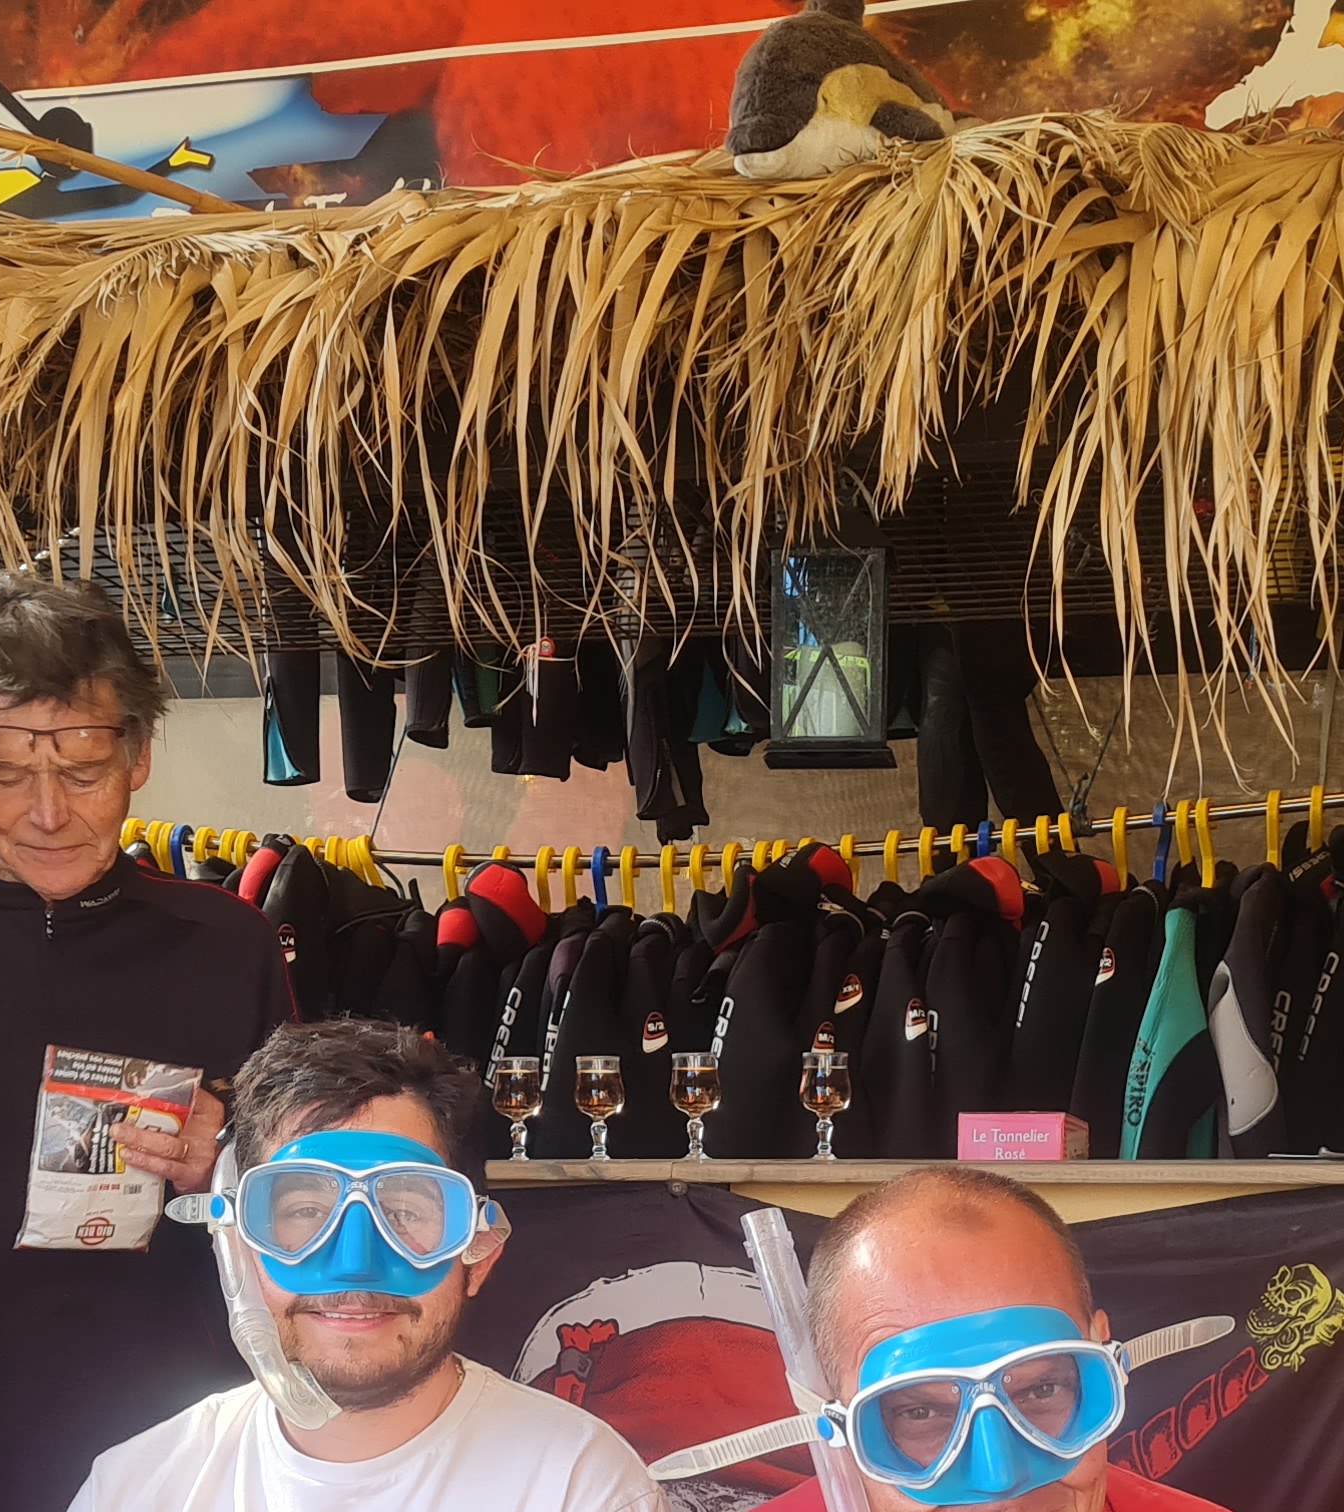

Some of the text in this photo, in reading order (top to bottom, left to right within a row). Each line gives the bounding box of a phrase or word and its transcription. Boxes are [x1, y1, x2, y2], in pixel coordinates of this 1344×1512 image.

[973, 1127, 1049, 1144] Le Tonnelier
[994, 1145, 1027, 1159] Rosé
